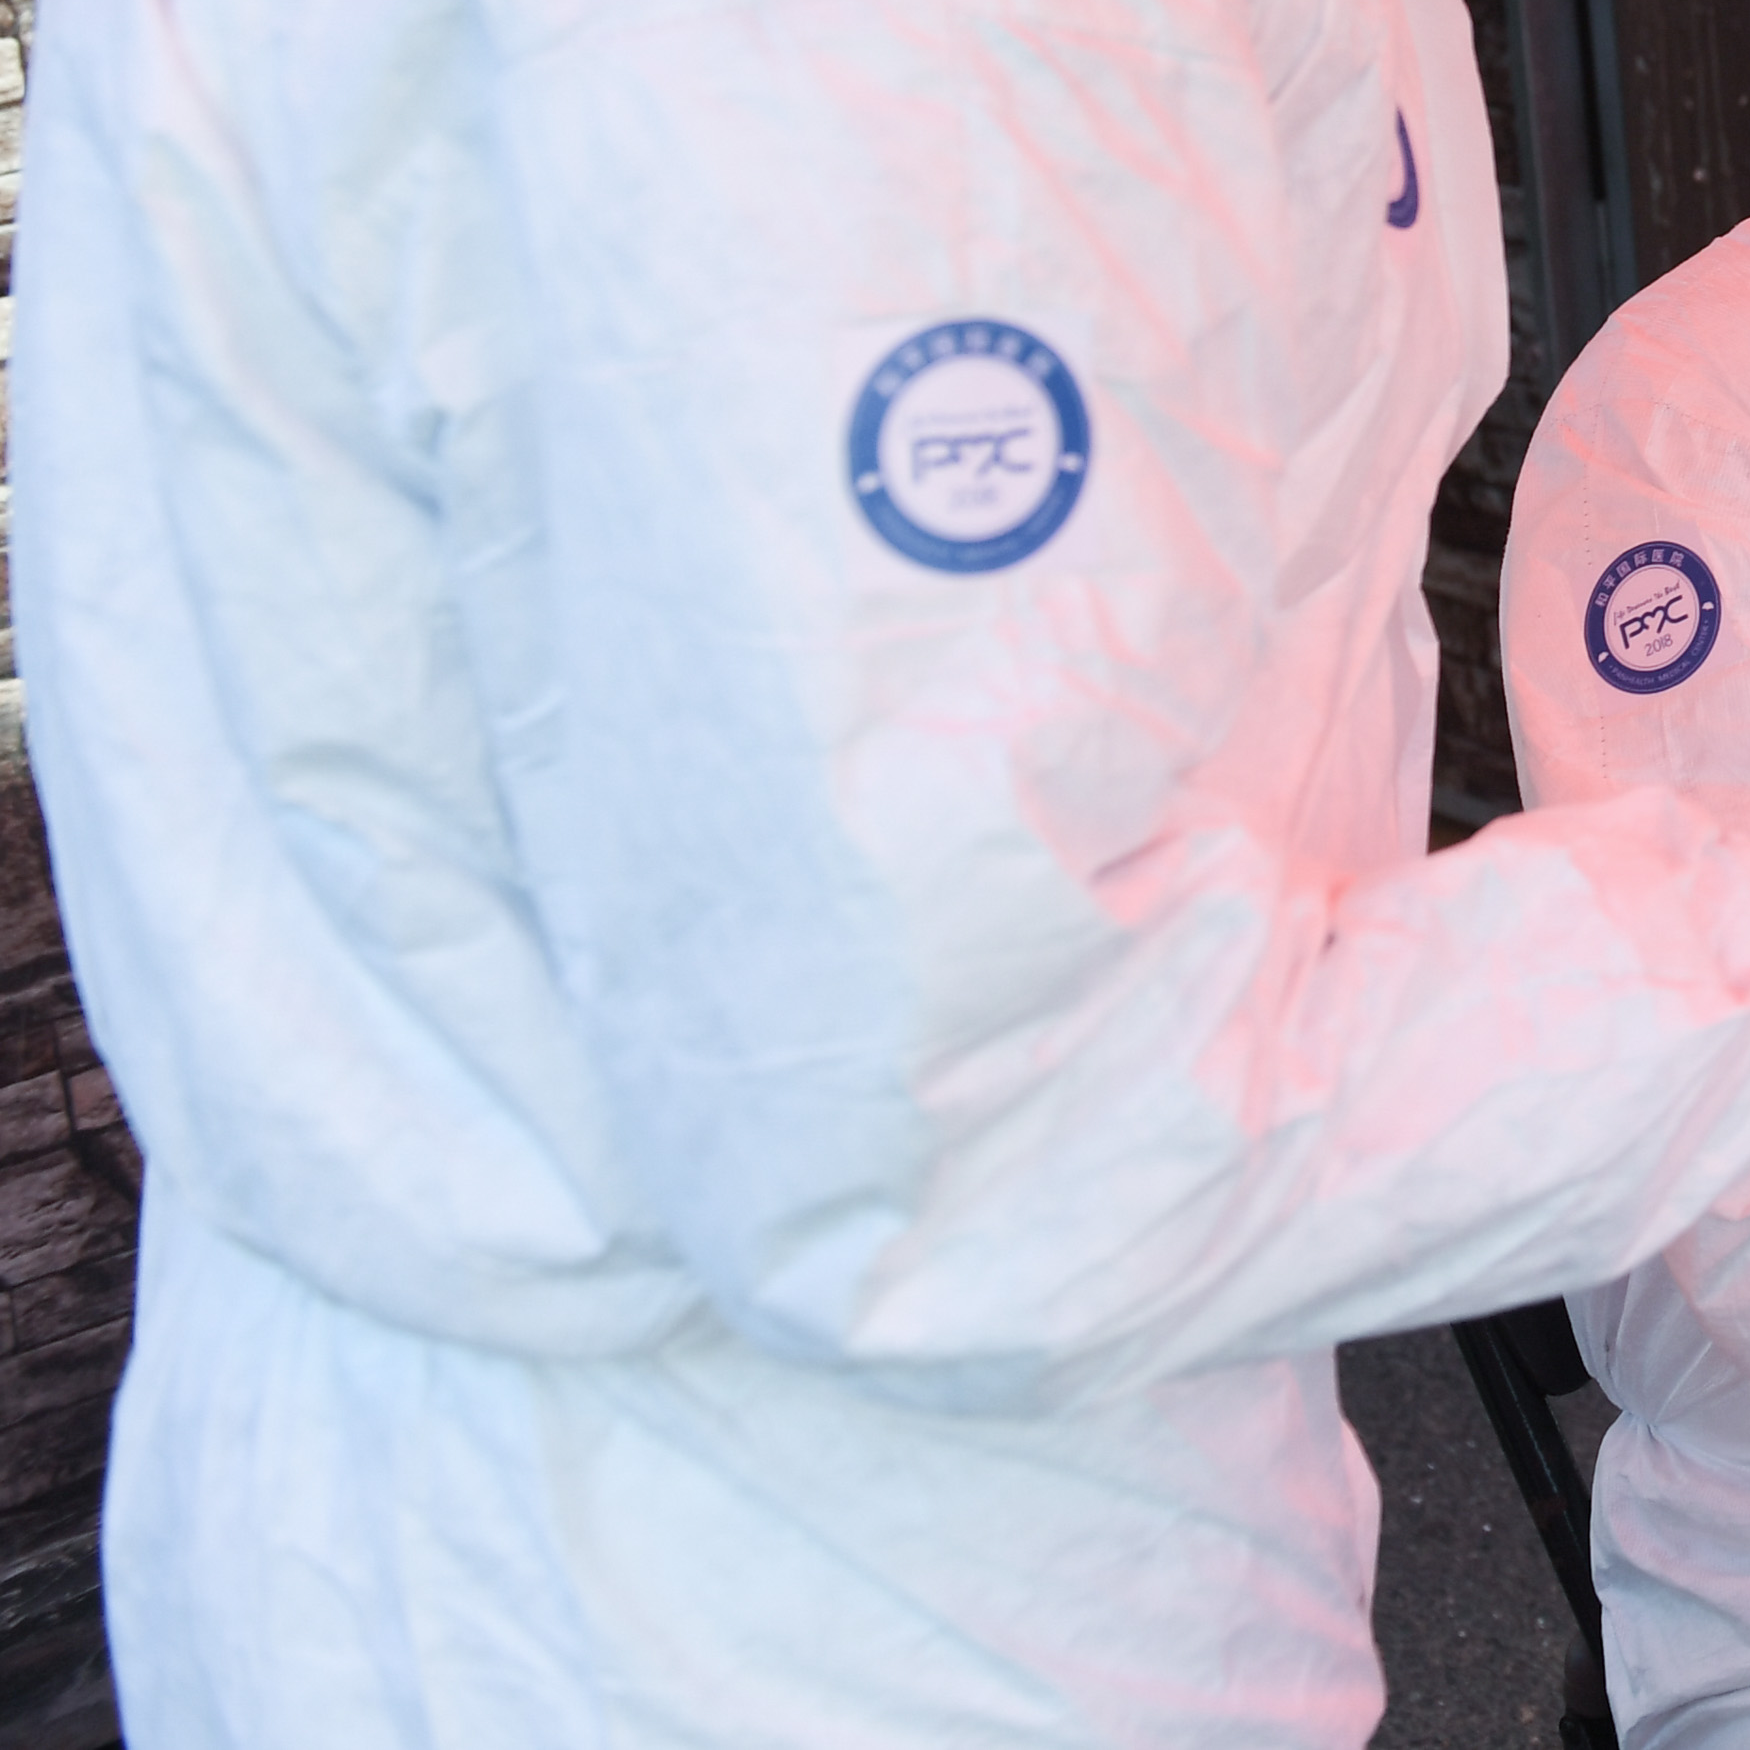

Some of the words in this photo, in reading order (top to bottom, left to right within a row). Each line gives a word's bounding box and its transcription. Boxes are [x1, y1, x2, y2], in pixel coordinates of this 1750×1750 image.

[1595, 549, 1685, 608] 和平国际医院
[1619, 594, 1689, 650] PMC
[1643, 633, 1674, 657] 2018
